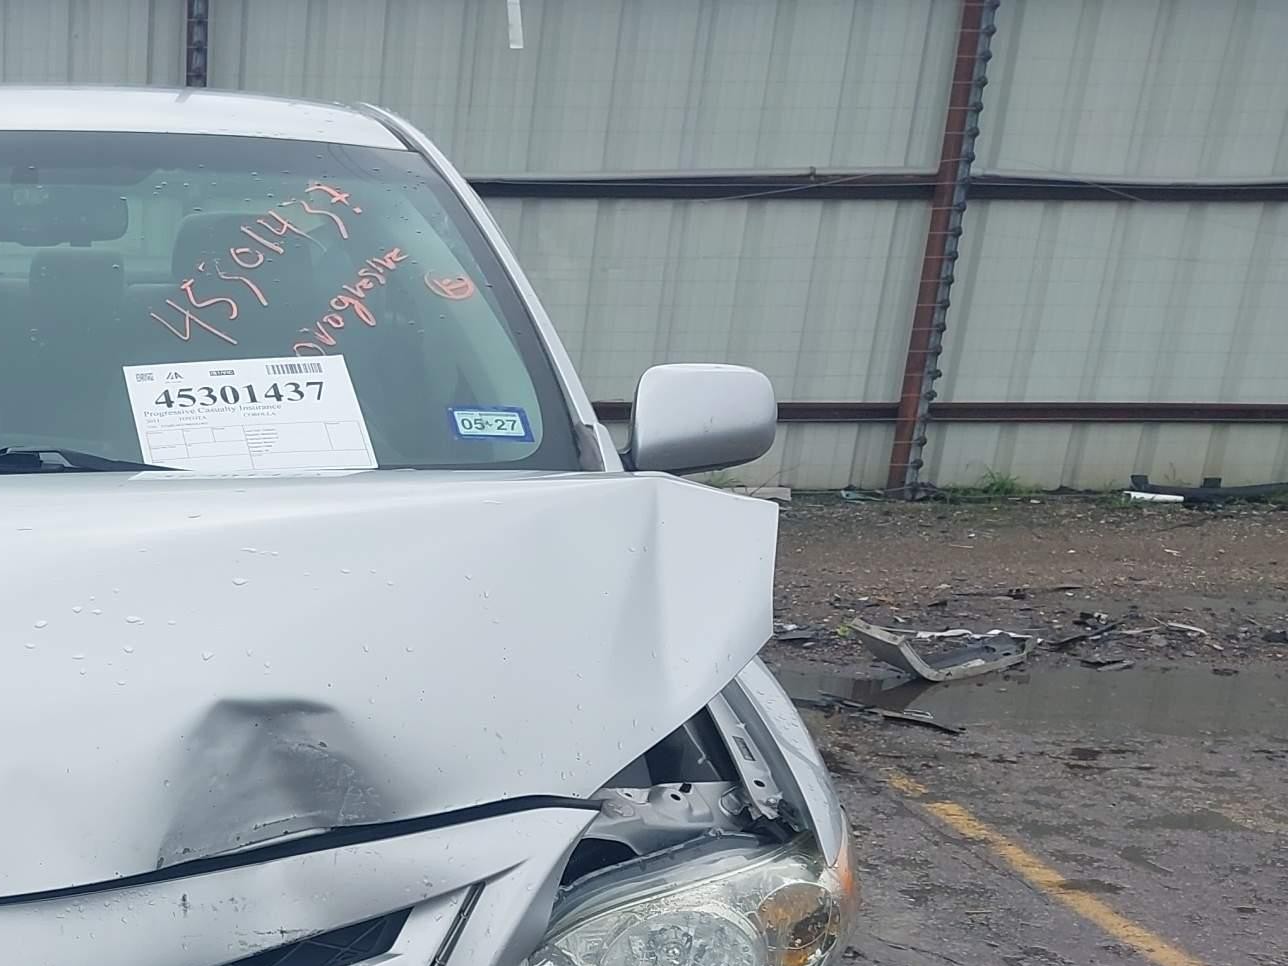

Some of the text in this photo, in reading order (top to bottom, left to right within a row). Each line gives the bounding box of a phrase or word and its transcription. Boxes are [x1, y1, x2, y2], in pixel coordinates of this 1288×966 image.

[155, 381, 324, 408] 45301437
[143, 402, 282, 418] Progressive Casualty Insurance
